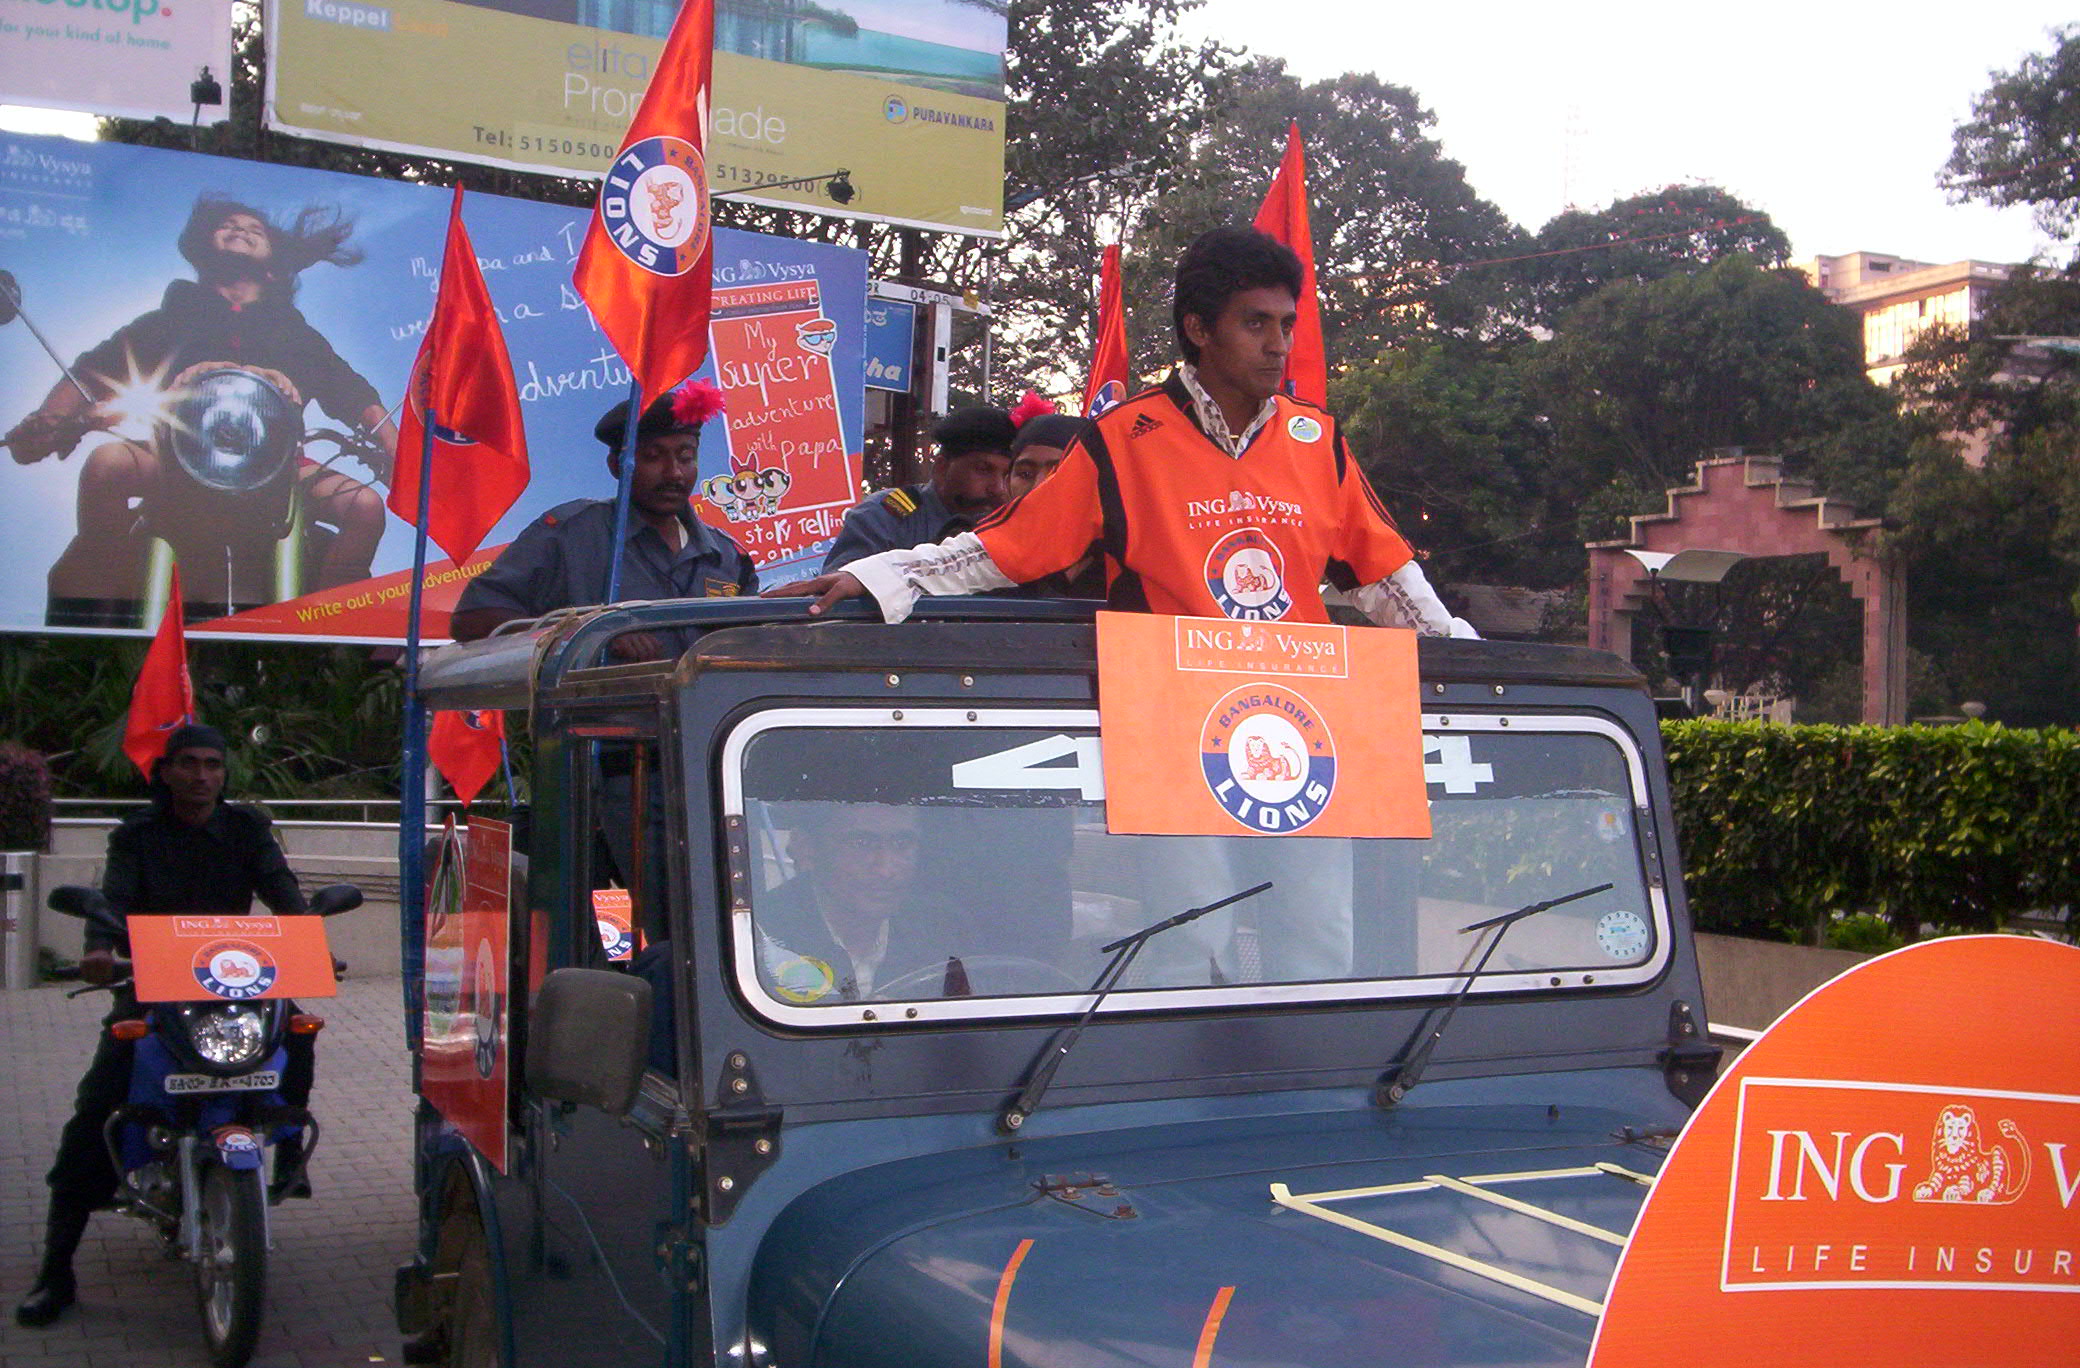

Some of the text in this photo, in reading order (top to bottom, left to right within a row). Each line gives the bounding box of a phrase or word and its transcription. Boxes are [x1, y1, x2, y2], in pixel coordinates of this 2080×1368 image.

[306, 0, 388, 27] Keppel
[65, 24, 100, 41] kind
[912, 106, 995, 132] PURAVANKARA
[473, 126, 513, 148] Tel:
[606, 152, 660, 267] LIONS
[712, 262, 816, 283] NG Vysya
[788, 287, 820, 305] LIFE
[744, 321, 777, 361] My
[731, 393, 834, 431] adventure
[747, 431, 778, 451] with
[1187, 496, 1303, 517] ING Vysya
[1189, 519, 1221, 529] LIFE
[296, 601, 343, 624] Write
[346, 591, 374, 610] out
[376, 584, 411, 604] your
[1187, 630, 1336, 660] ING Vysya
[1186, 660, 1339, 674] LIFE INSURANCE
[1219, 694, 1315, 732] BANGALORE
[1215, 778, 1328, 830] LIONS
[181, 919, 209, 929] ING
[202, 976, 272, 998] LIONS
[1760, 1130, 1908, 1203] ING
[1752, 1245, 2073, 1276] LIFE INSUR
